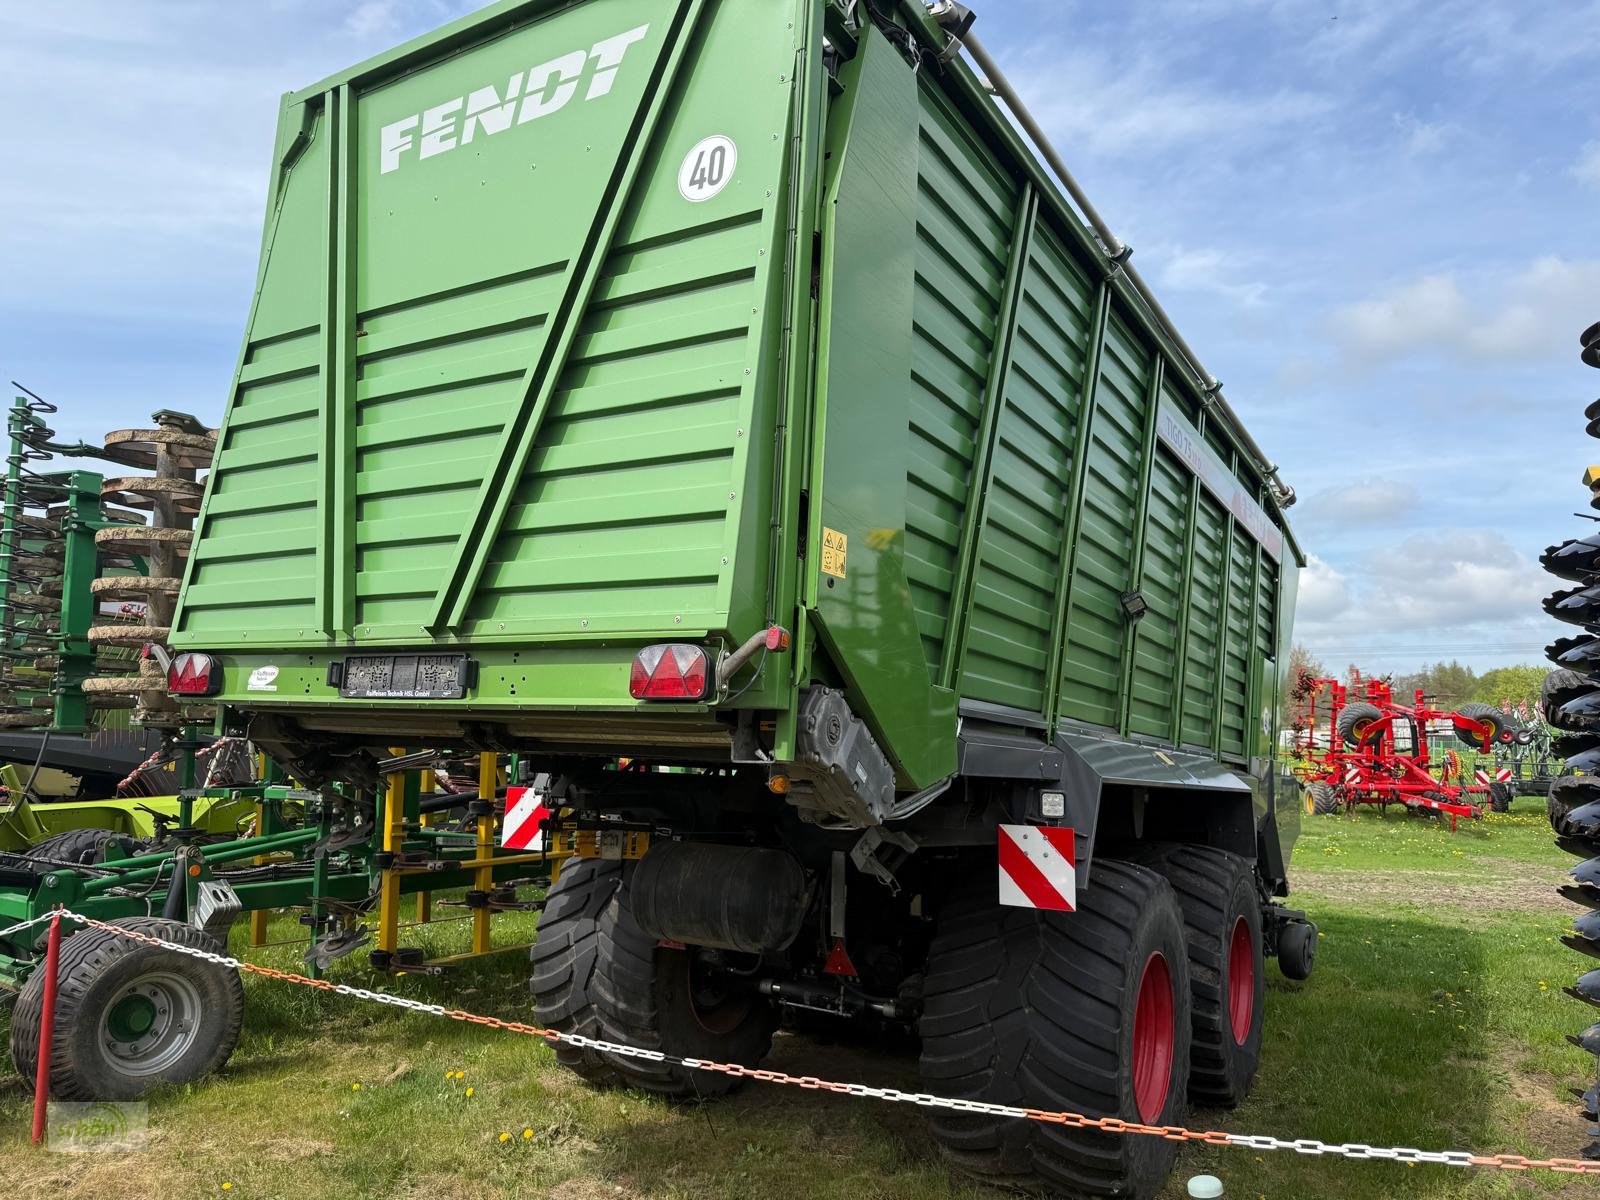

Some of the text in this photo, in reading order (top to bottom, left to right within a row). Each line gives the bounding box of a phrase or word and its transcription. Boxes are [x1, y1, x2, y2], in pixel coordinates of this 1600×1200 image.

[381, 23, 650, 175] FENDT
[689, 145, 726, 190] 40
[1166, 415, 1192, 460] TIGO 75
